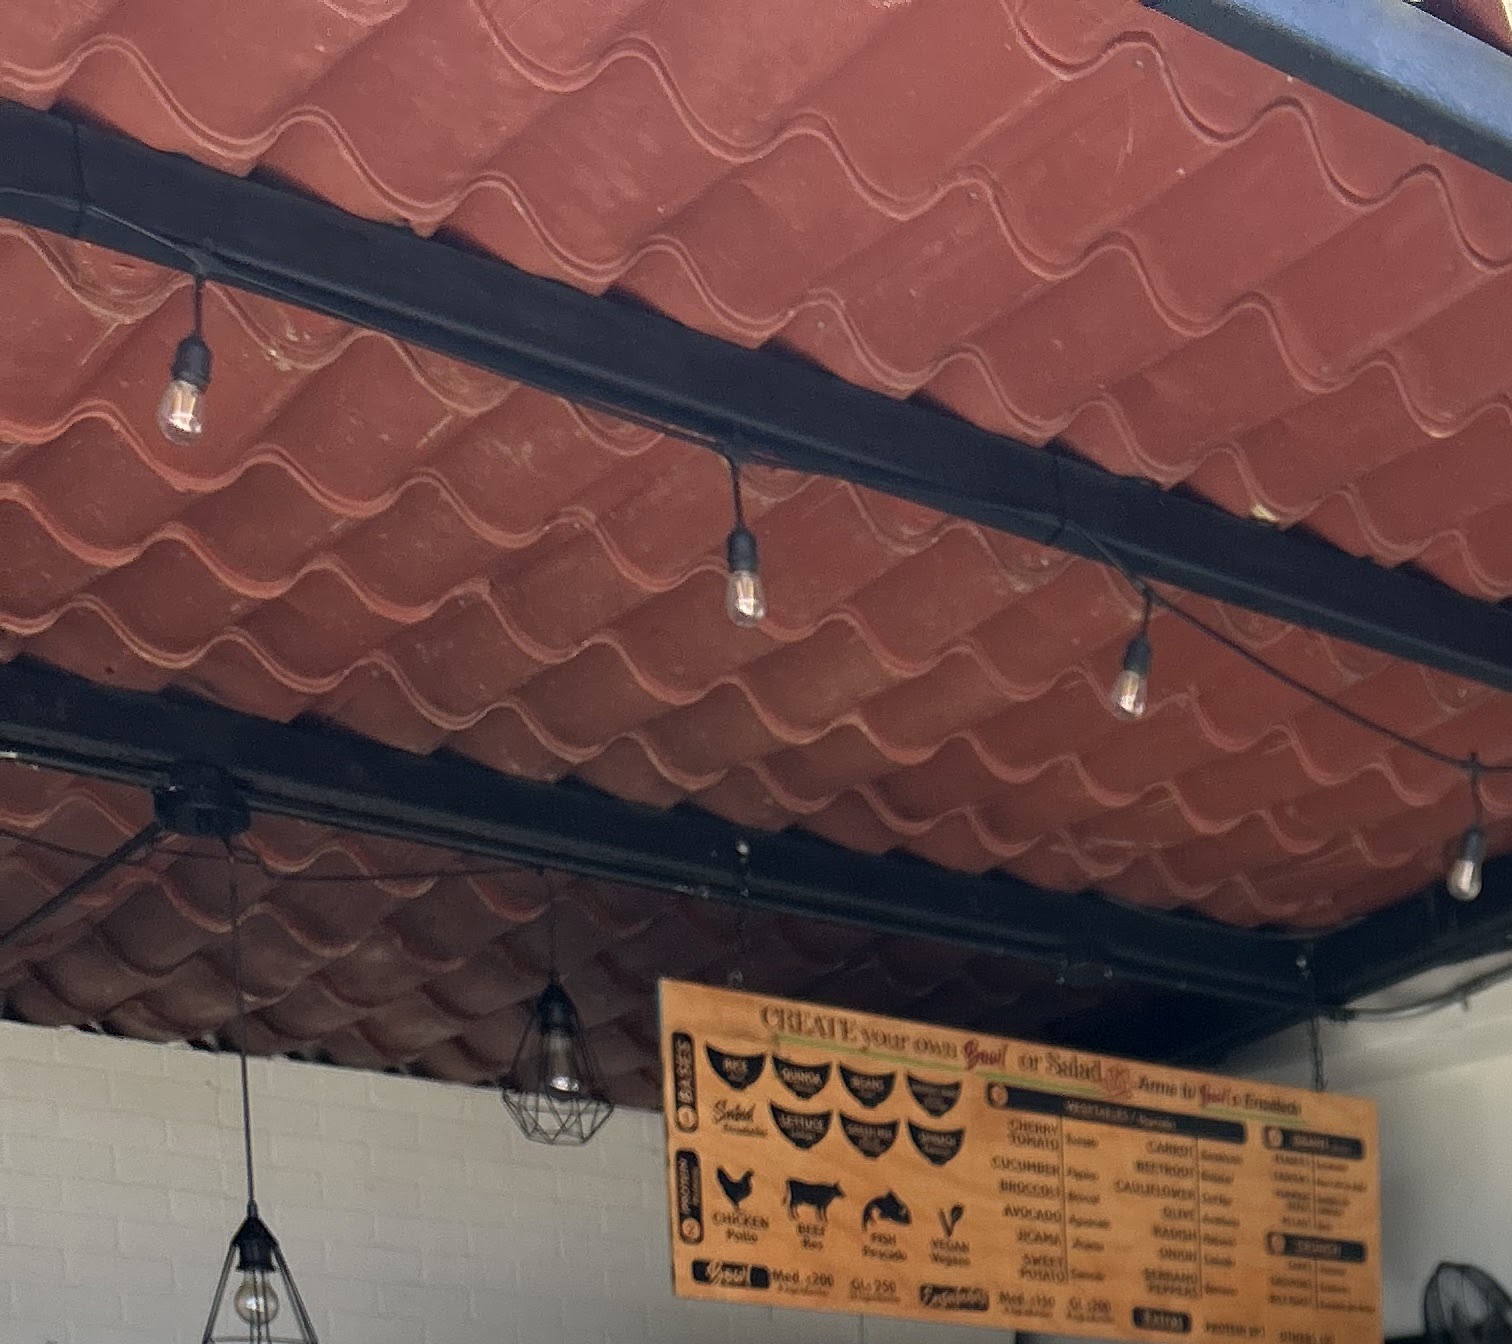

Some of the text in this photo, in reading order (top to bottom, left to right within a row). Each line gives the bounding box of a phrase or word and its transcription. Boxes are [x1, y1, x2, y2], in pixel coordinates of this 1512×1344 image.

[761, 1005, 857, 1041] CREATE
[858, 1026, 911, 1051] your
[914, 1038, 958, 1058] own
[1018, 1052, 1042, 1072] or
[1046, 1051, 1101, 1084] Salad
[1007, 1117, 1059, 1136] CHERRY
[1008, 1132, 1060, 1152] TOMATO
[1148, 1140, 1195, 1159] CARROT
[991, 1156, 1061, 1177] CUCUMBER
[1114, 1180, 1197, 1201] CAULIFLOWER
[712, 1211, 769, 1230] CHICKEN
[1003, 1202, 1063, 1223] AVOCADO
[726, 1229, 759, 1244] Pollo
[870, 1231, 898, 1245] FISH
[930, 1238, 971, 1254] VEGAN
